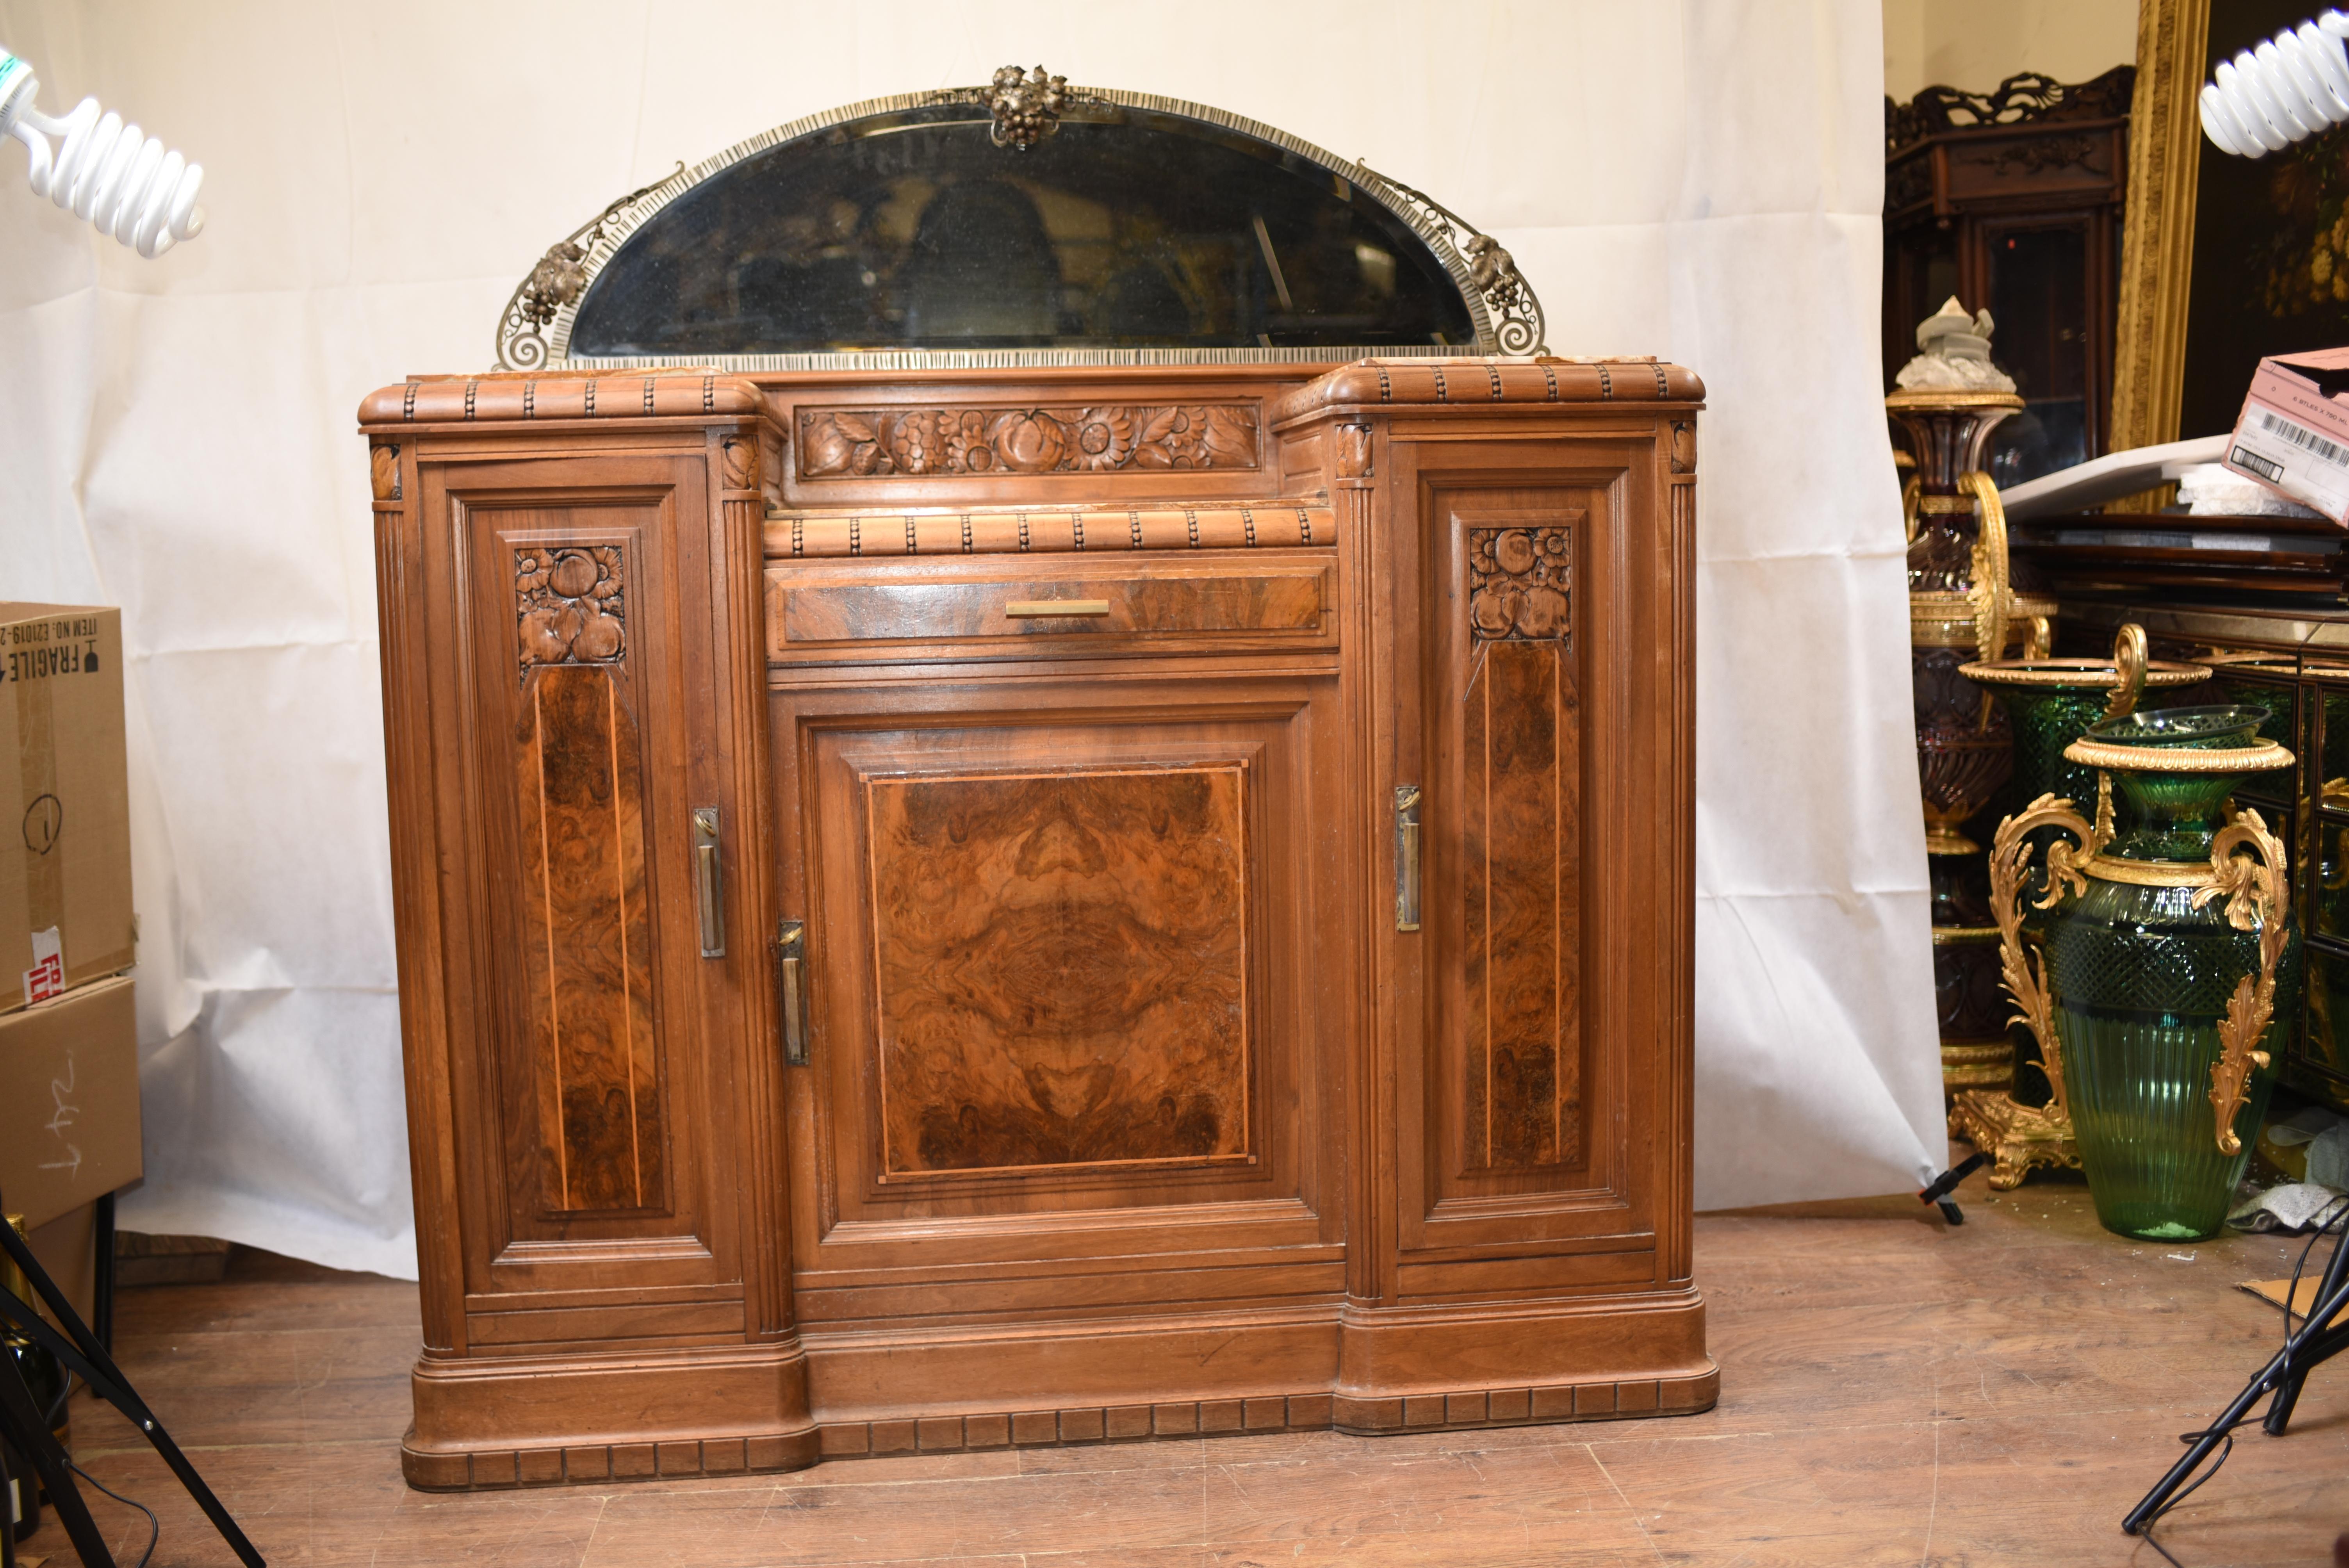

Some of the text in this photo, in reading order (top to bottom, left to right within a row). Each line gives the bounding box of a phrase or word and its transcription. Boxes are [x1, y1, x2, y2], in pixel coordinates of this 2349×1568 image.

[2299, 399, 2319, 411] BTLES
[2326, 411, 2337, 420] 750
[2339, 417, 2348, 426] ML
[52, 622, 70, 640] NO:
[73, 618, 97, 637] ITEM
[9, 644, 79, 682] FRAGILE
[41, 953, 62, 994] FR
